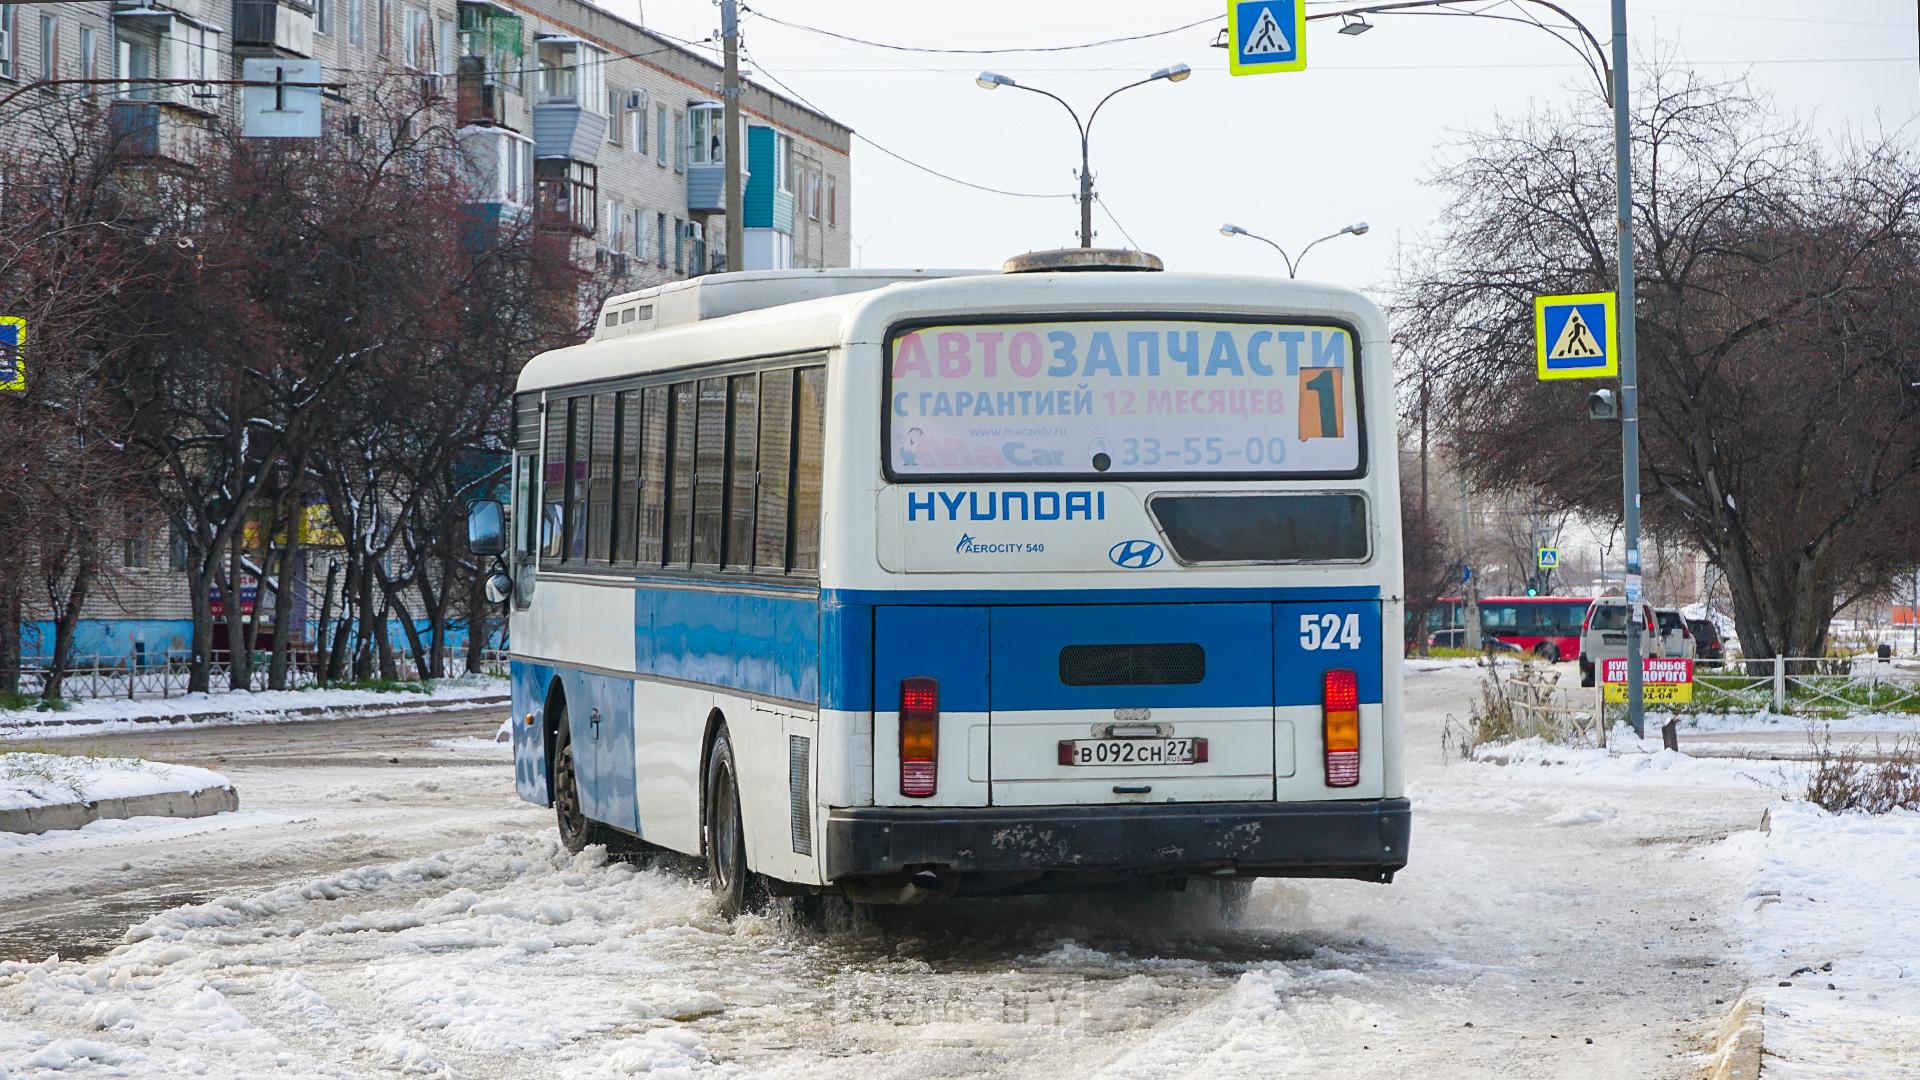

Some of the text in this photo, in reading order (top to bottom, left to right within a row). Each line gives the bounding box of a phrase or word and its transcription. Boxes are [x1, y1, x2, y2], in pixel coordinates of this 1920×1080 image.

[892, 331, 1345, 378] АВТОЗАПЧАСТИ
[893, 383, 1286, 418] С ГАРАНТИЕЙ 12 МЕСЯЦЕВ
[1305, 369, 1339, 438] 1
[968, 426, 1067, 438] www.macardv.ru
[1120, 436, 1287, 467] 33-55-00
[908, 491, 1105, 522] HYUNDAI
[959, 538, 1045, 554] AEROCITY 540
[1299, 613, 1362, 650] 524
[1649, 660, 1687, 671] ЛЮБОЕ
[1167, 741, 1188, 756] 27
